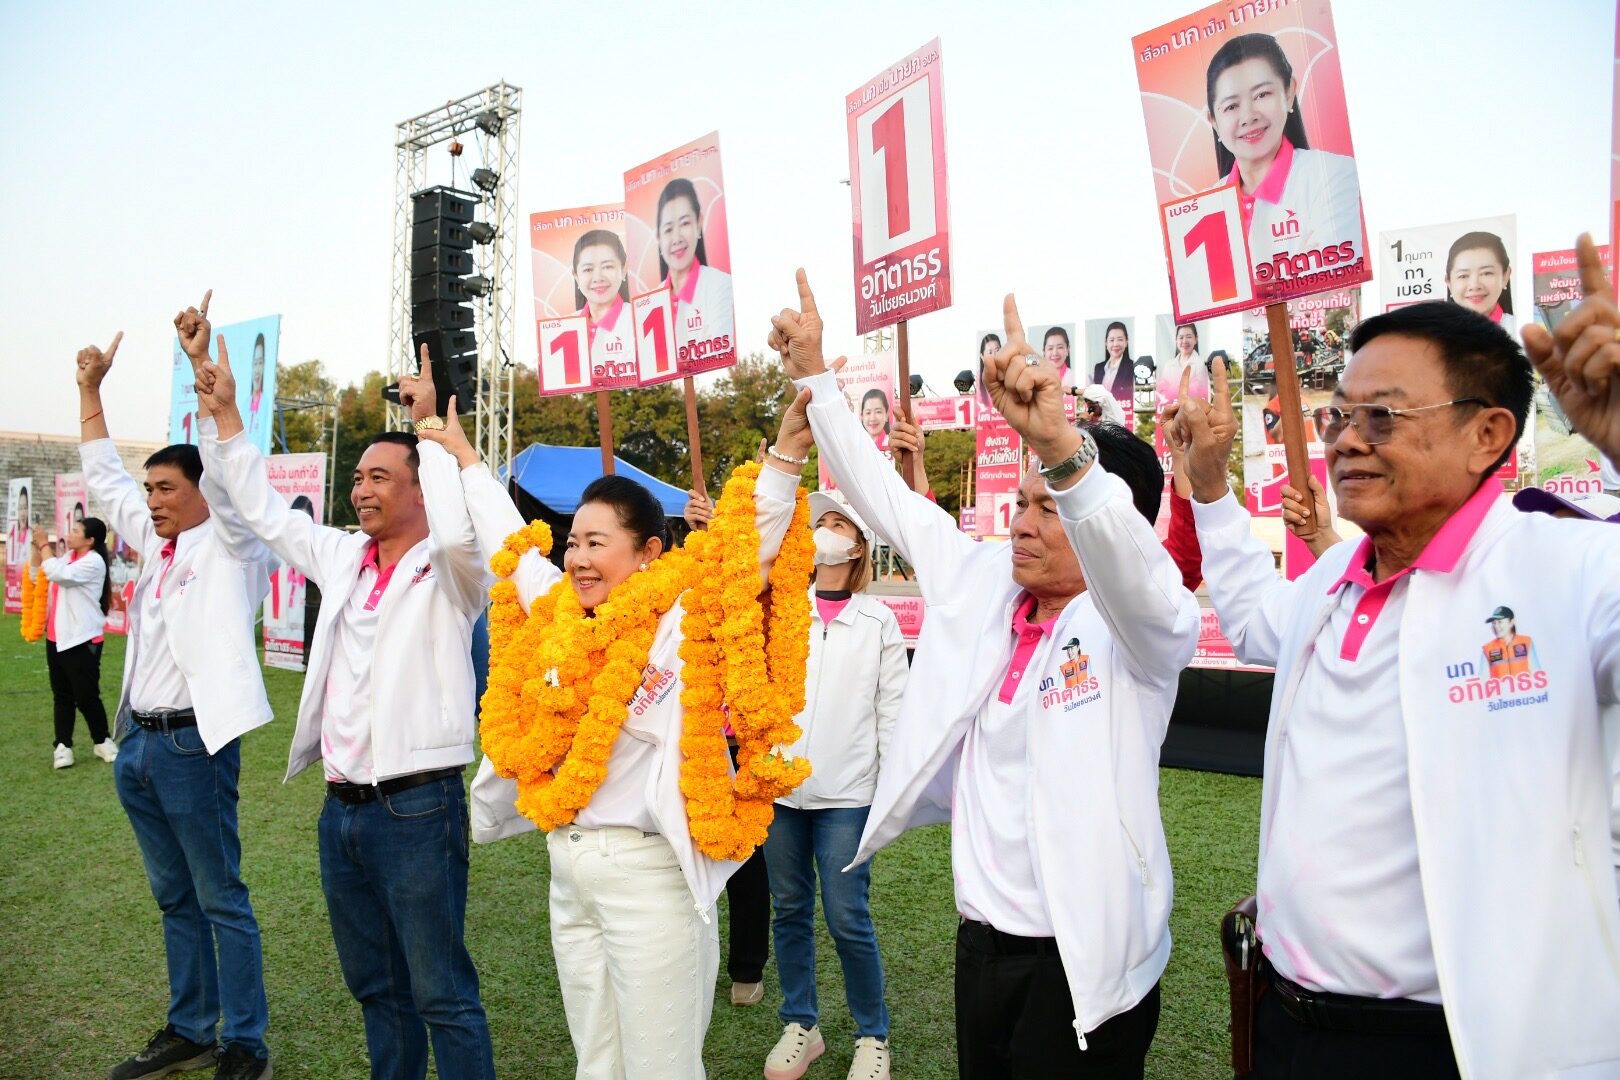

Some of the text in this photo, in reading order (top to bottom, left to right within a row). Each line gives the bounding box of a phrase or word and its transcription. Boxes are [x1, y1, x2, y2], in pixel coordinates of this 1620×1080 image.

[1140, 45, 1170, 63] เลือก
[1170, 26, 1200, 50] นก
[1203, 19, 1226, 39] เป็น
[871, 96, 911, 240] 1
[1169, 198, 1199, 218] เบอร์
[554, 215, 573, 229] นก
[1183, 210, 1238, 302] 1
[1255, 240, 1355, 282] อทิตาธร
[1391, 240, 1433, 264] 1 กุมภา
[861, 247, 942, 300] อทิตาธร
[1404, 267, 1424, 280] กา
[869, 277, 937, 318] วันไชยธนวงศ์
[1397, 278, 1432, 297] เบอร์
[643, 306, 669, 373] 1
[550, 330, 581, 385] 1
[593, 360, 635, 377] อทิตา
[959, 400, 971, 425] 1
[1545, 476, 1602, 495] อทิตา
[1000, 503, 1010, 528] 1
[1446, 661, 1475, 679] นก
[1042, 676, 1099, 709] อทิตาธร
[1448, 670, 1549, 704] อทิตาธร
[1487, 692, 1549, 713] วันไชยธนวงศ์
